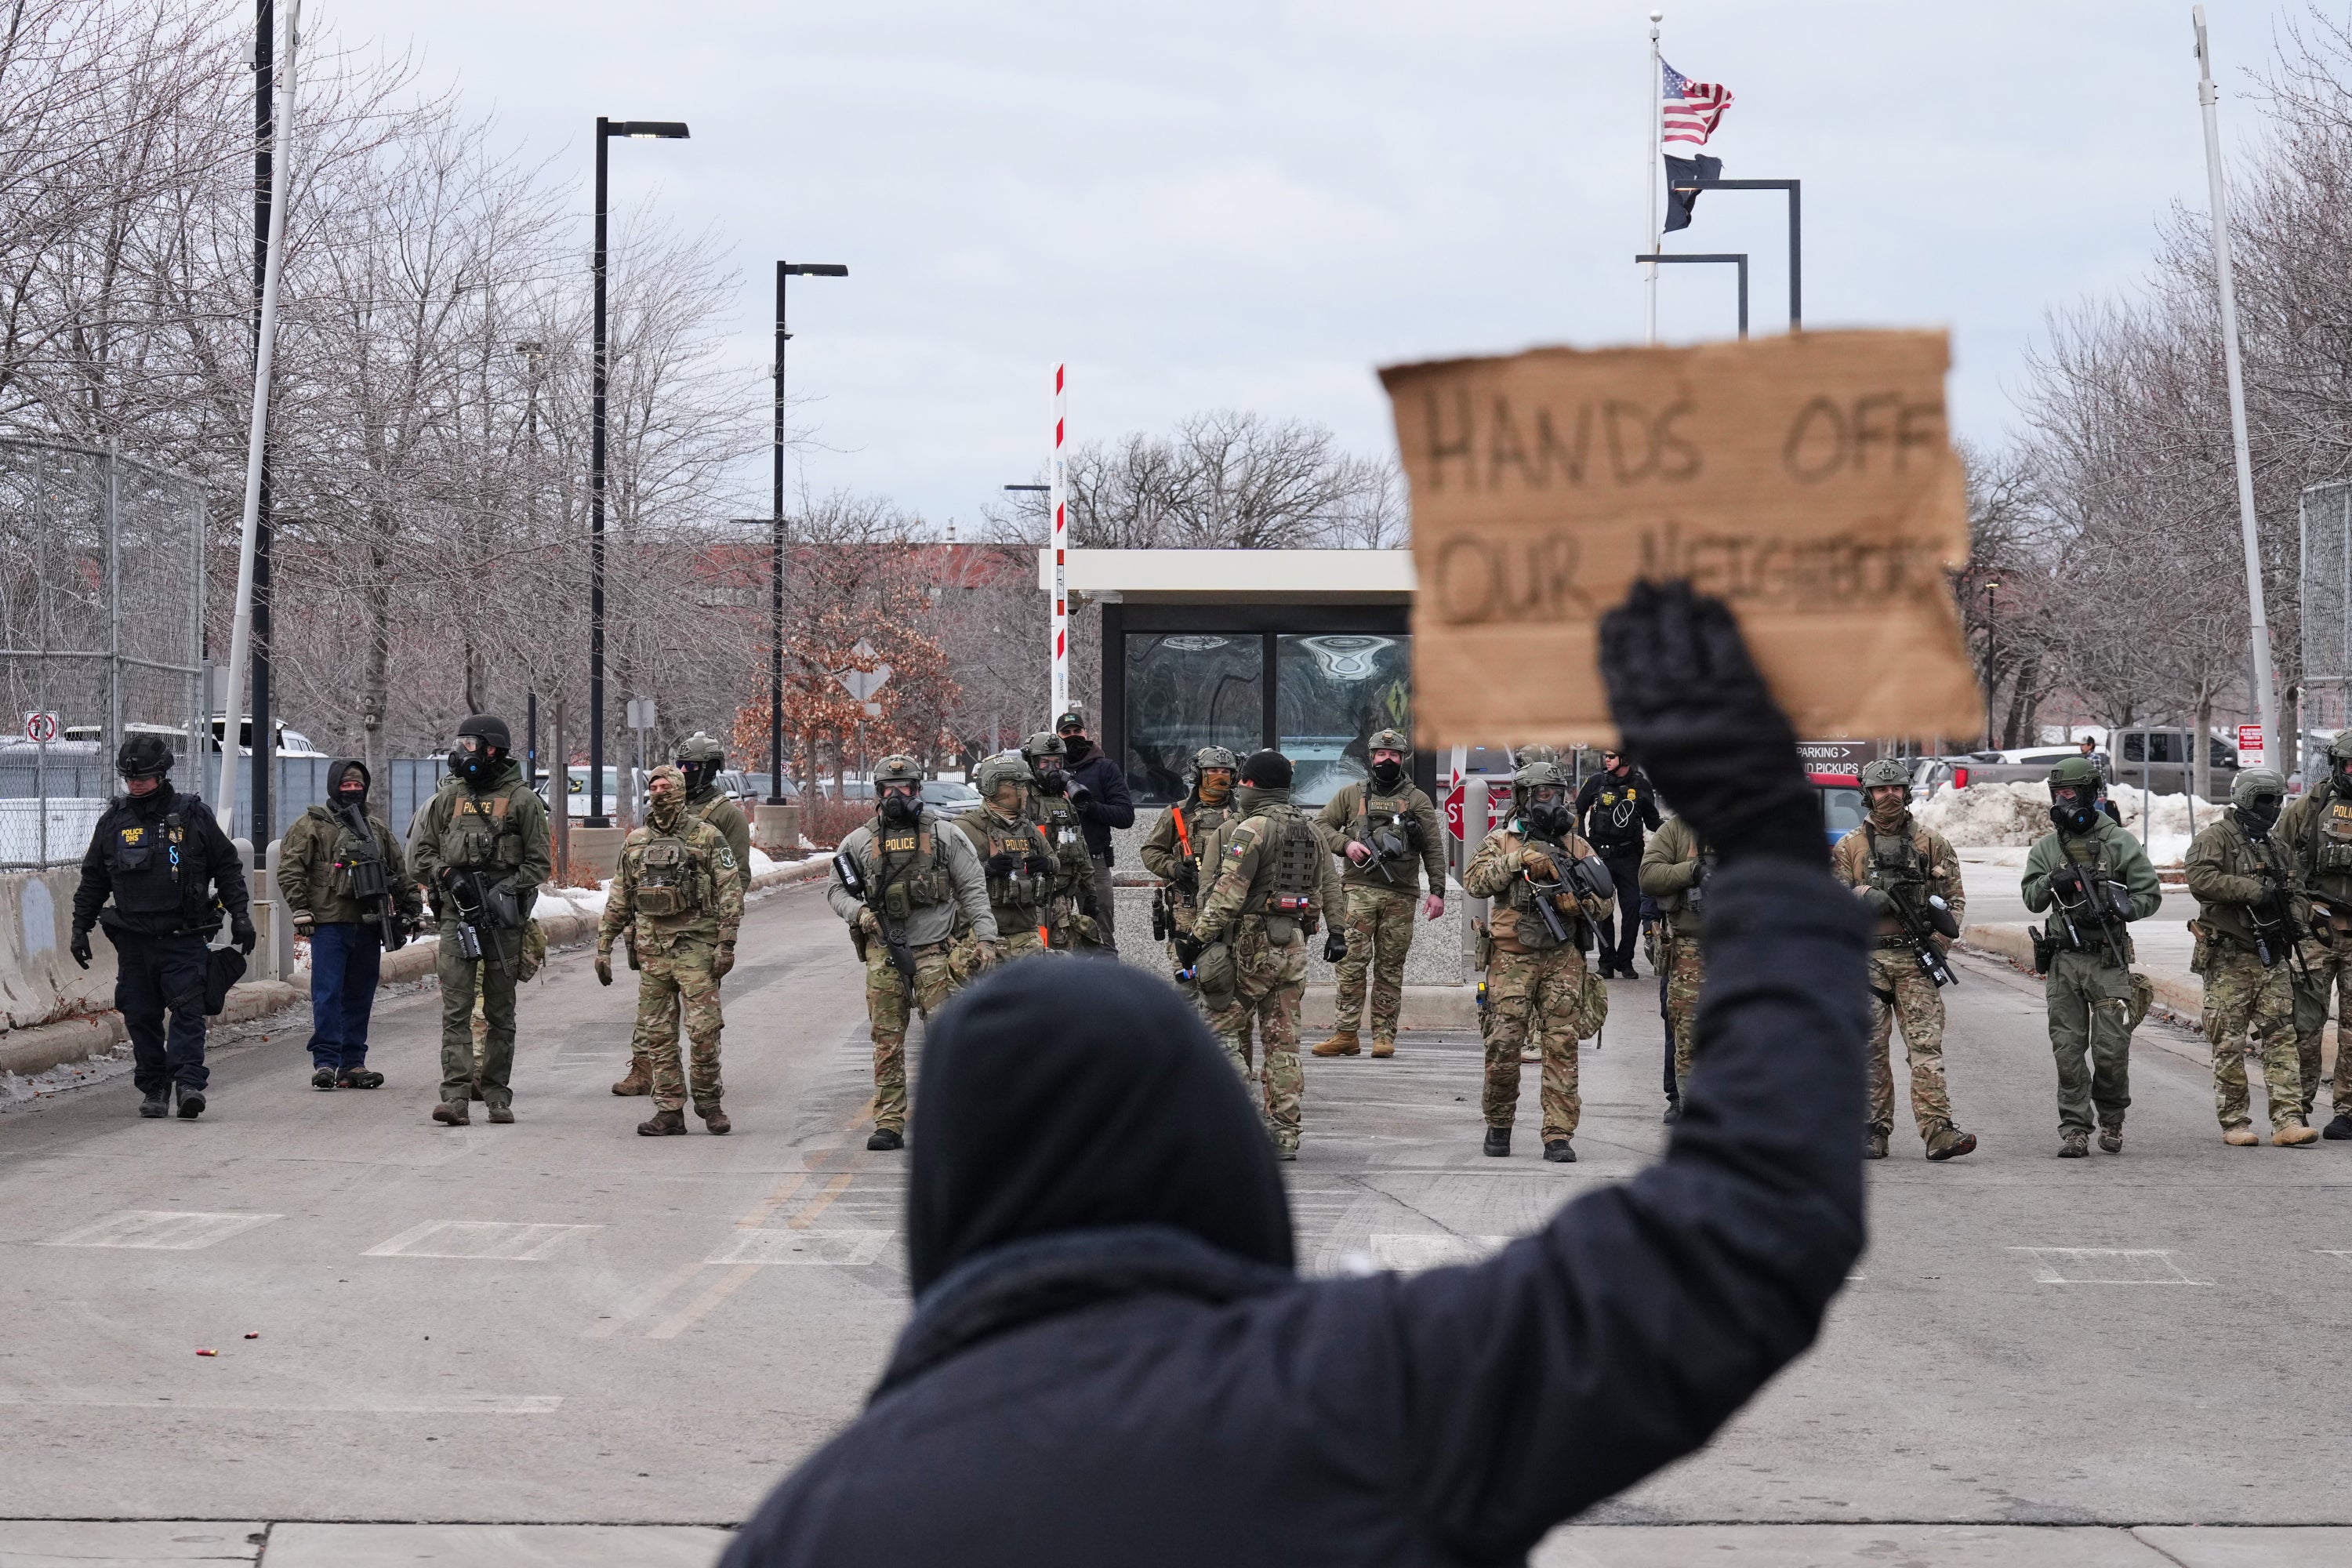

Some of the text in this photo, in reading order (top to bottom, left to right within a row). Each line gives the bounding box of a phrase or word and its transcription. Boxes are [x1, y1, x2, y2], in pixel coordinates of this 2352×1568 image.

[1421, 384, 1946, 494] HANDS OFF
[1433, 532, 1596, 625] OUR
[1796, 747, 1838, 758] PARKING
[1816, 763, 1859, 775] PICKUPS
[463, 802, 492, 813] POCE
[2333, 805, 2352, 818] POLI
[122, 828, 143, 837] POLICE
[885, 837, 915, 851] POLICE
[1005, 840, 1029, 851] POLICE
